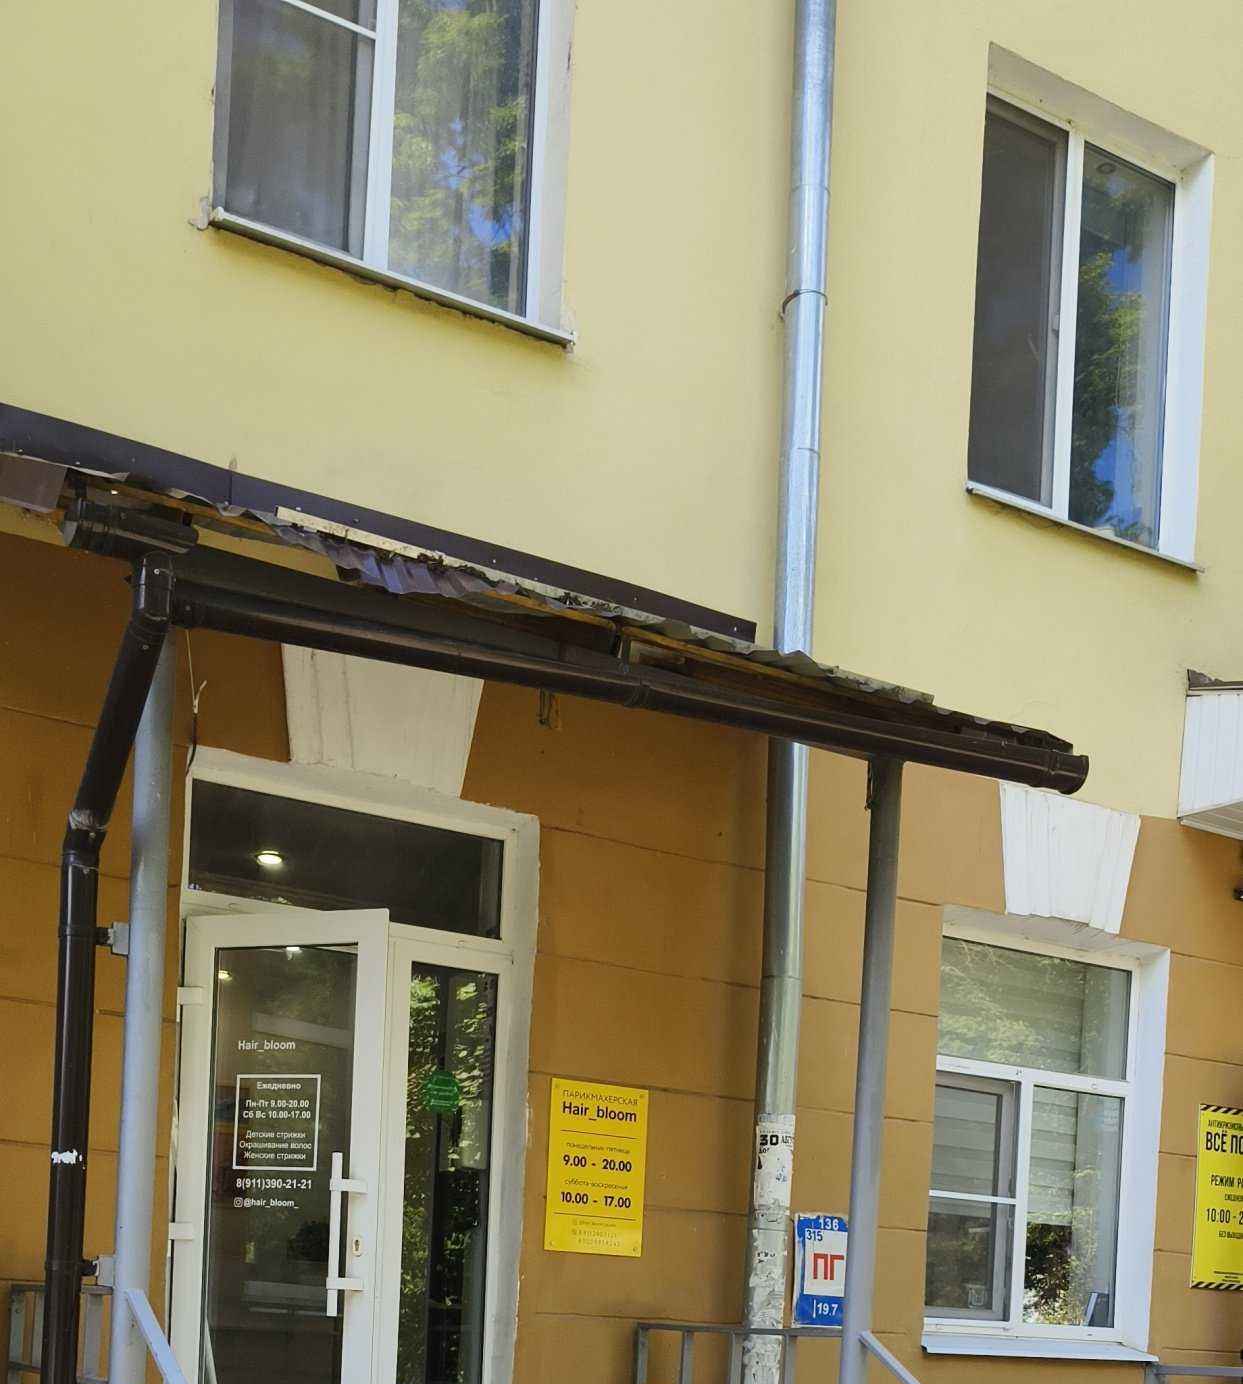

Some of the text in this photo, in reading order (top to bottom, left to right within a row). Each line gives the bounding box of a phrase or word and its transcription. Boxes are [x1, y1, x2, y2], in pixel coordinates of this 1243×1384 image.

[238, 1040, 296, 1053] Hair_bloom
[256, 1081, 302, 1091] Ежедневно
[246, 1099, 310, 1108] Пн-Пт 9.00-20.00
[563, 1090, 638, 1106] ПАРИКМАХЕРСКАЯ
[243, 1110, 311, 1119] Сб Вс 10.00-17.00
[562, 1101, 637, 1122] Hair_bloom
[245, 1130, 306, 1140] Детские стрижки
[759, 1134, 779, 1146] 30
[1205, 1130, 1228, 1153] ВСЁ
[239, 1140, 289, 1149] Окрашивание
[244, 1151, 307, 1160] Женские стрижки
[563, 1154, 587, 1168] 9.00
[602, 1158, 632, 1173] 20.00
[236, 1178, 312, 1190] 8(911)390-21-21
[1210, 1174, 1235, 1188] РЕЖИМ
[561, 1191, 589, 1205] 10.00
[604, 1195, 631, 1209] 17.00
[1206, 1208, 1231, 1224] 10:00
[819, 1218, 840, 1230] 136
[806, 1229, 824, 1242] 315
[813, 1252, 845, 1281] ПГ
[816, 1302, 839, 1317] 19.7
